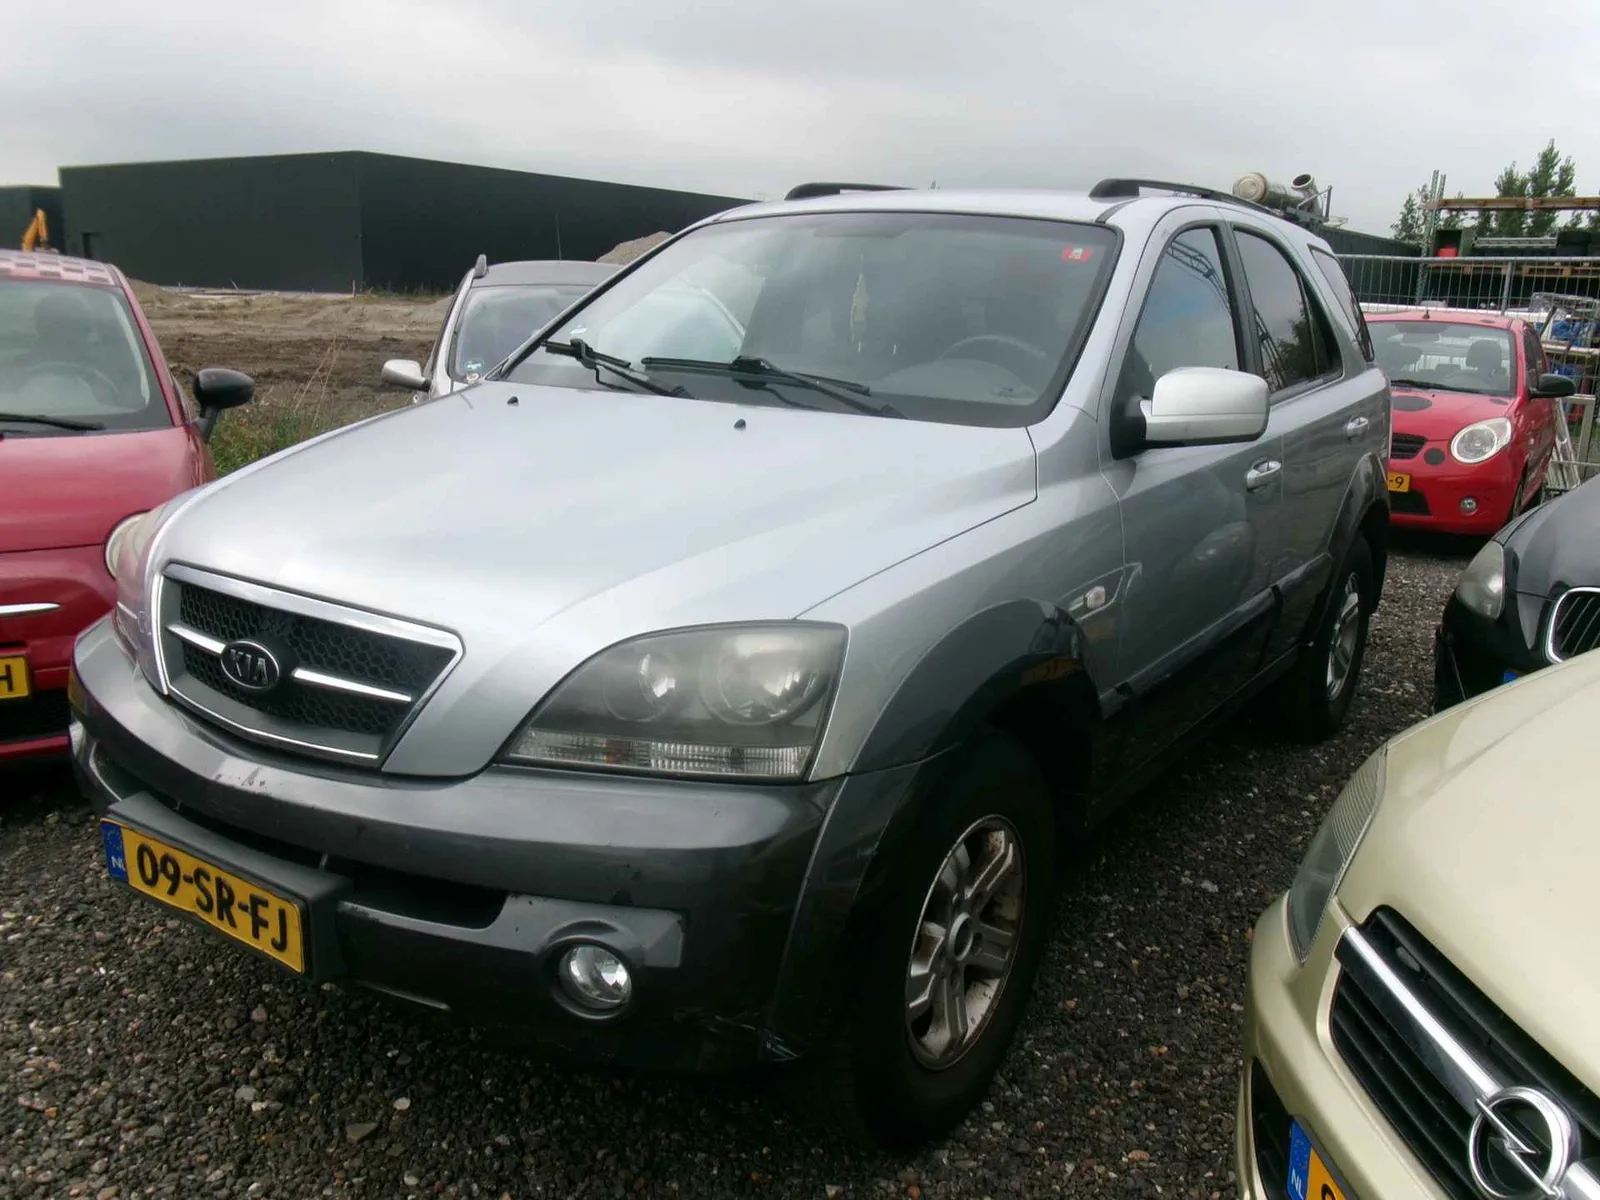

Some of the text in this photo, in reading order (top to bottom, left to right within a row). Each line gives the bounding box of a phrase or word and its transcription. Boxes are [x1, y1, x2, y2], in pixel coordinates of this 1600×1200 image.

[229, 648, 269, 684] KIA
[111, 855, 125, 871] NL
[137, 843, 288, 952] 09-SR-FJ
[1291, 1167, 1304, 1200] NL
